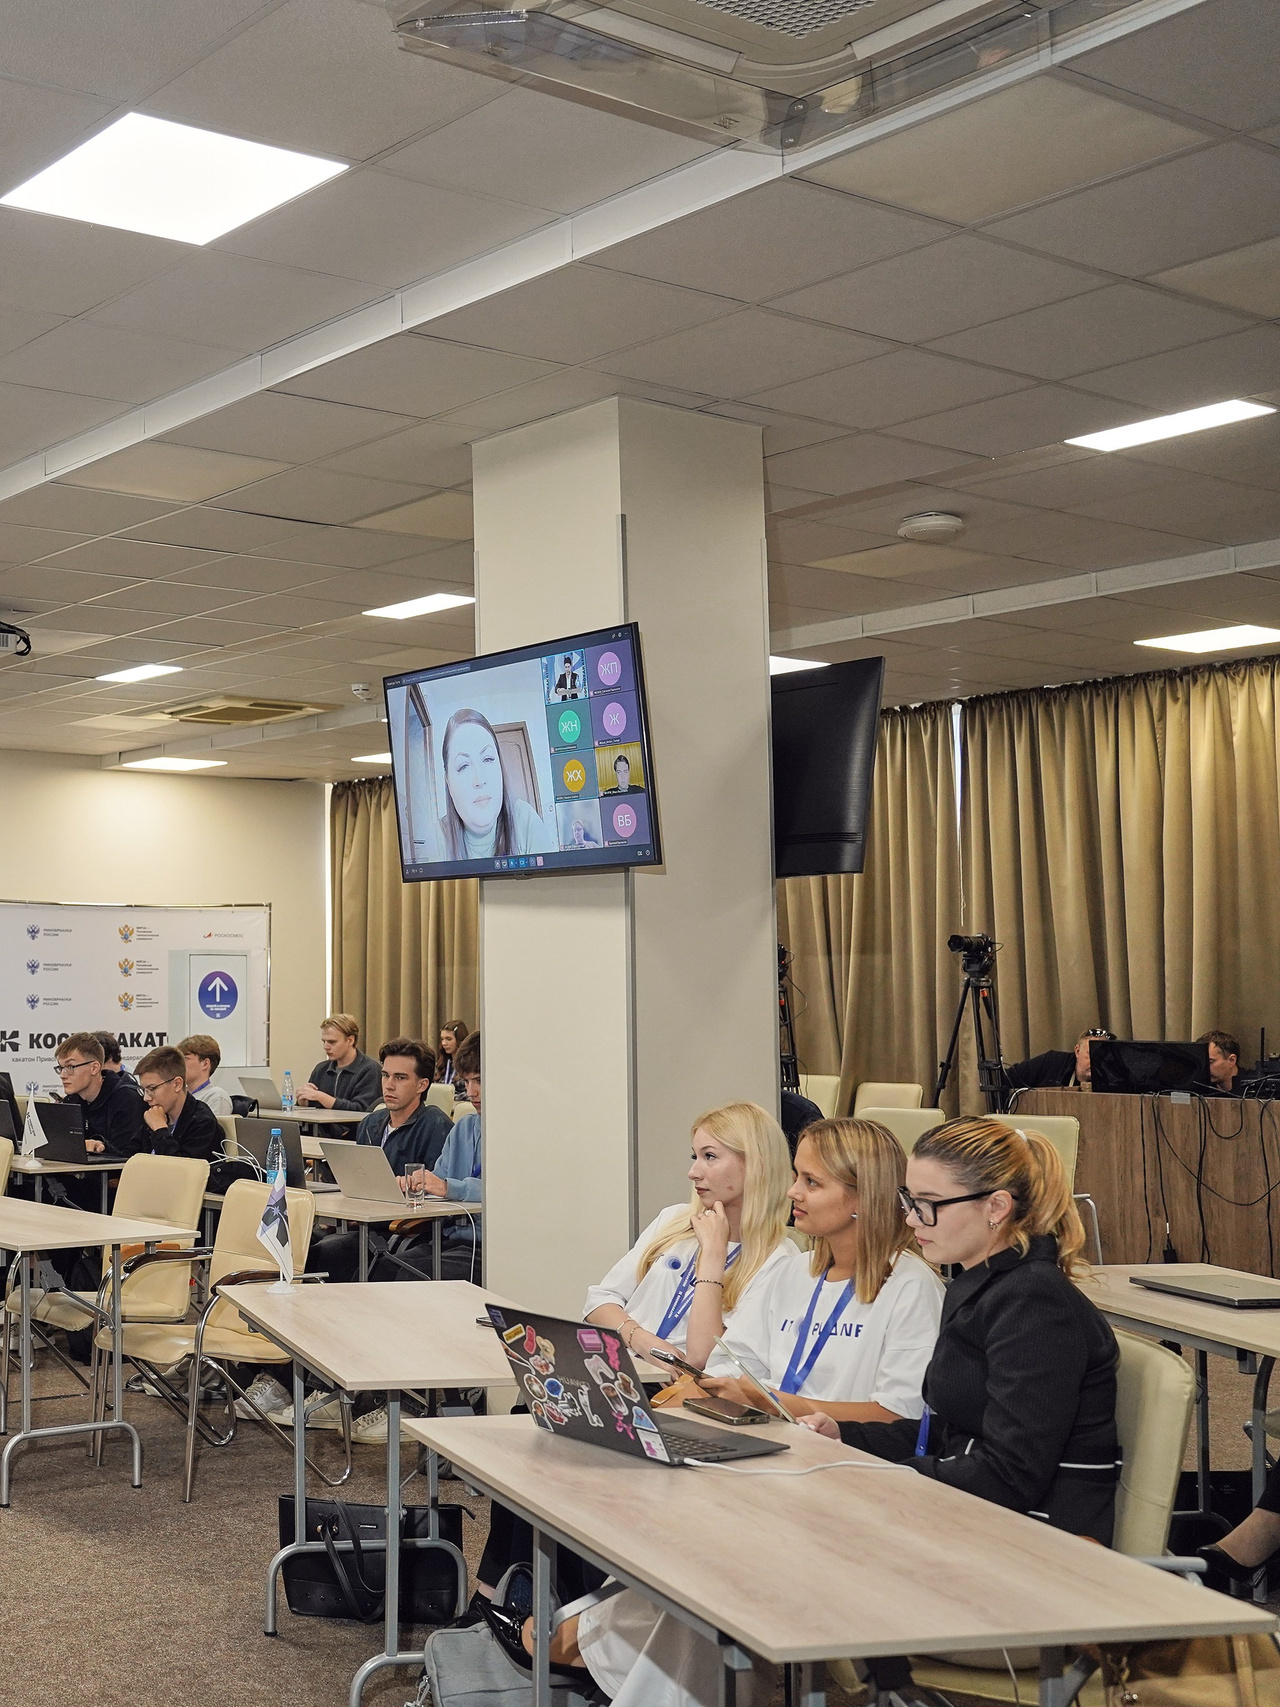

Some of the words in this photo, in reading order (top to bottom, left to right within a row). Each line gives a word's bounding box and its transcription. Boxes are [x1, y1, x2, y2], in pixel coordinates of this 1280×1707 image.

[600, 661, 618, 676] ЖП
[609, 713, 620, 726] Ж
[561, 720, 578, 734] ЖН
[566, 769, 583, 782] ЖХ
[617, 814, 632, 827] ВБ
